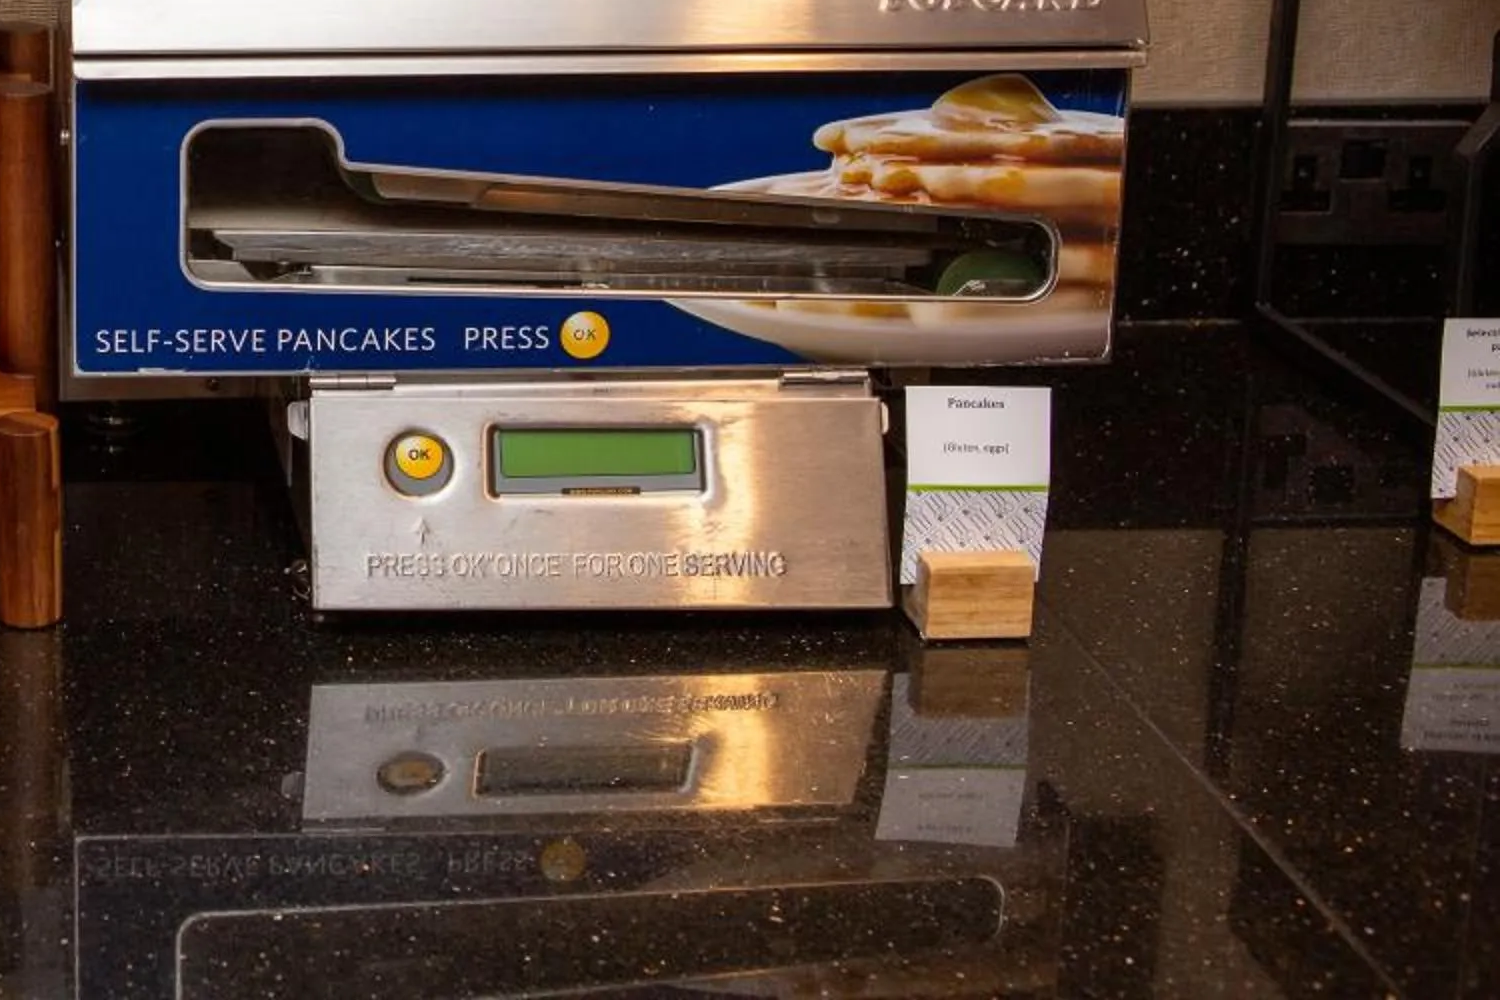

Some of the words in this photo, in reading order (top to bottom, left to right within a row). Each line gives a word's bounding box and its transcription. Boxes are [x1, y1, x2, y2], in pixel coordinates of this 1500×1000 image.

[95, 328, 267, 353] SELF-SERVE
[276, 327, 436, 352] PANCAKES
[463, 325, 550, 350] PRESS
[572, 328, 597, 341] OK
[947, 397, 1005, 409] Pancakes
[407, 448, 431, 461] OK
[366, 552, 446, 578] PRESS
[573, 552, 623, 578] FOR
[628, 552, 679, 578] ONE
[684, 551, 789, 578] SERVING
